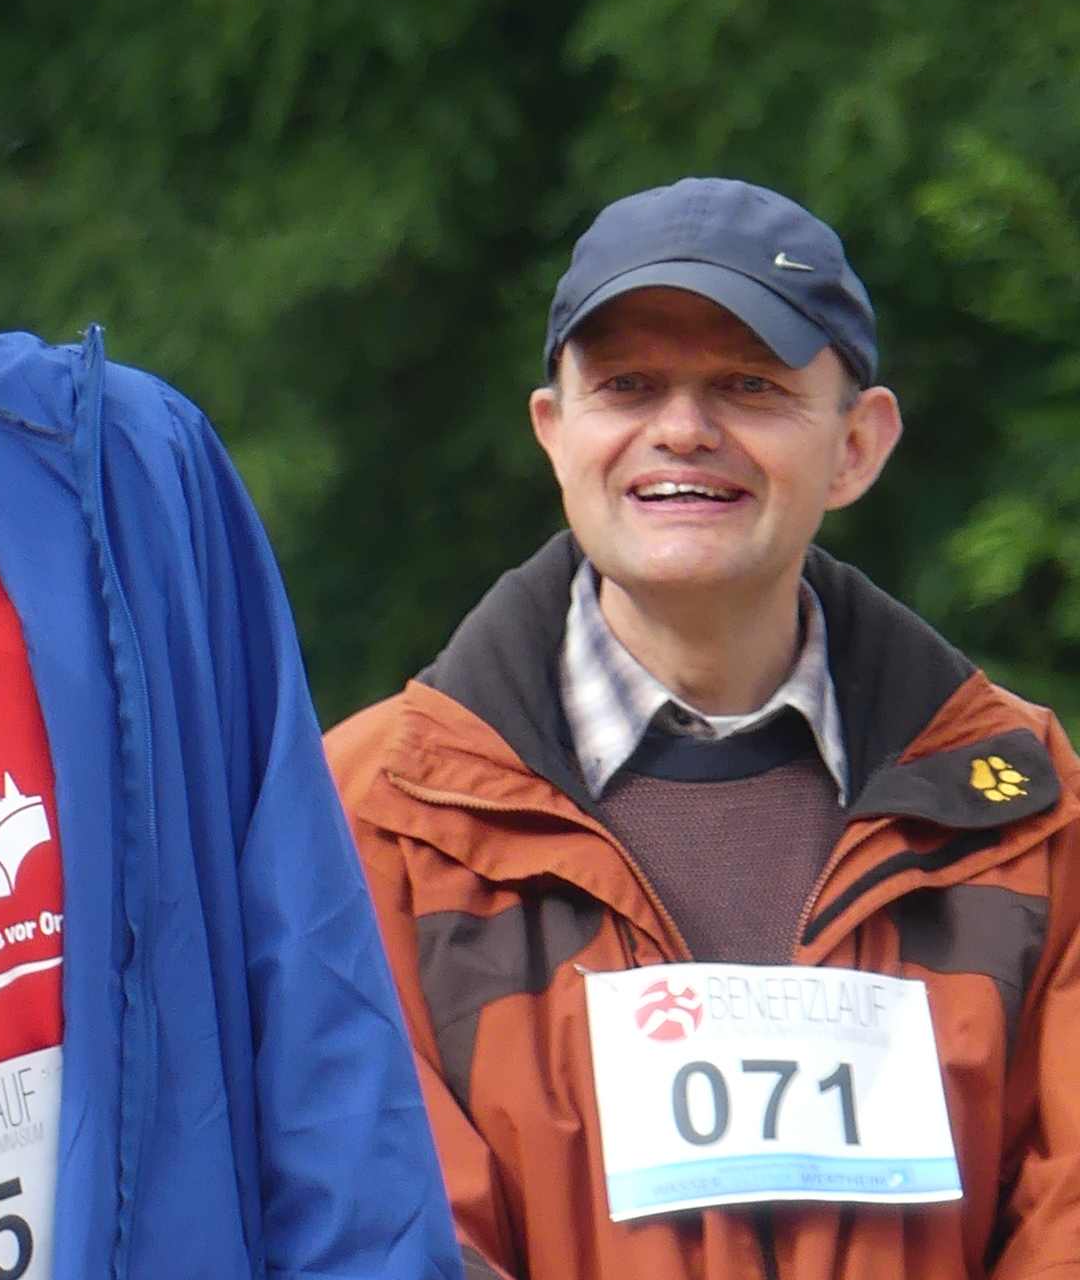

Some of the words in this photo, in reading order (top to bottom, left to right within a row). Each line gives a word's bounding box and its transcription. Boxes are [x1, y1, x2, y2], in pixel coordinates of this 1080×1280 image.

[4, 920, 37, 944] vor
[39, 910, 63, 936] Or
[672, 1059, 862, 1147] 071
